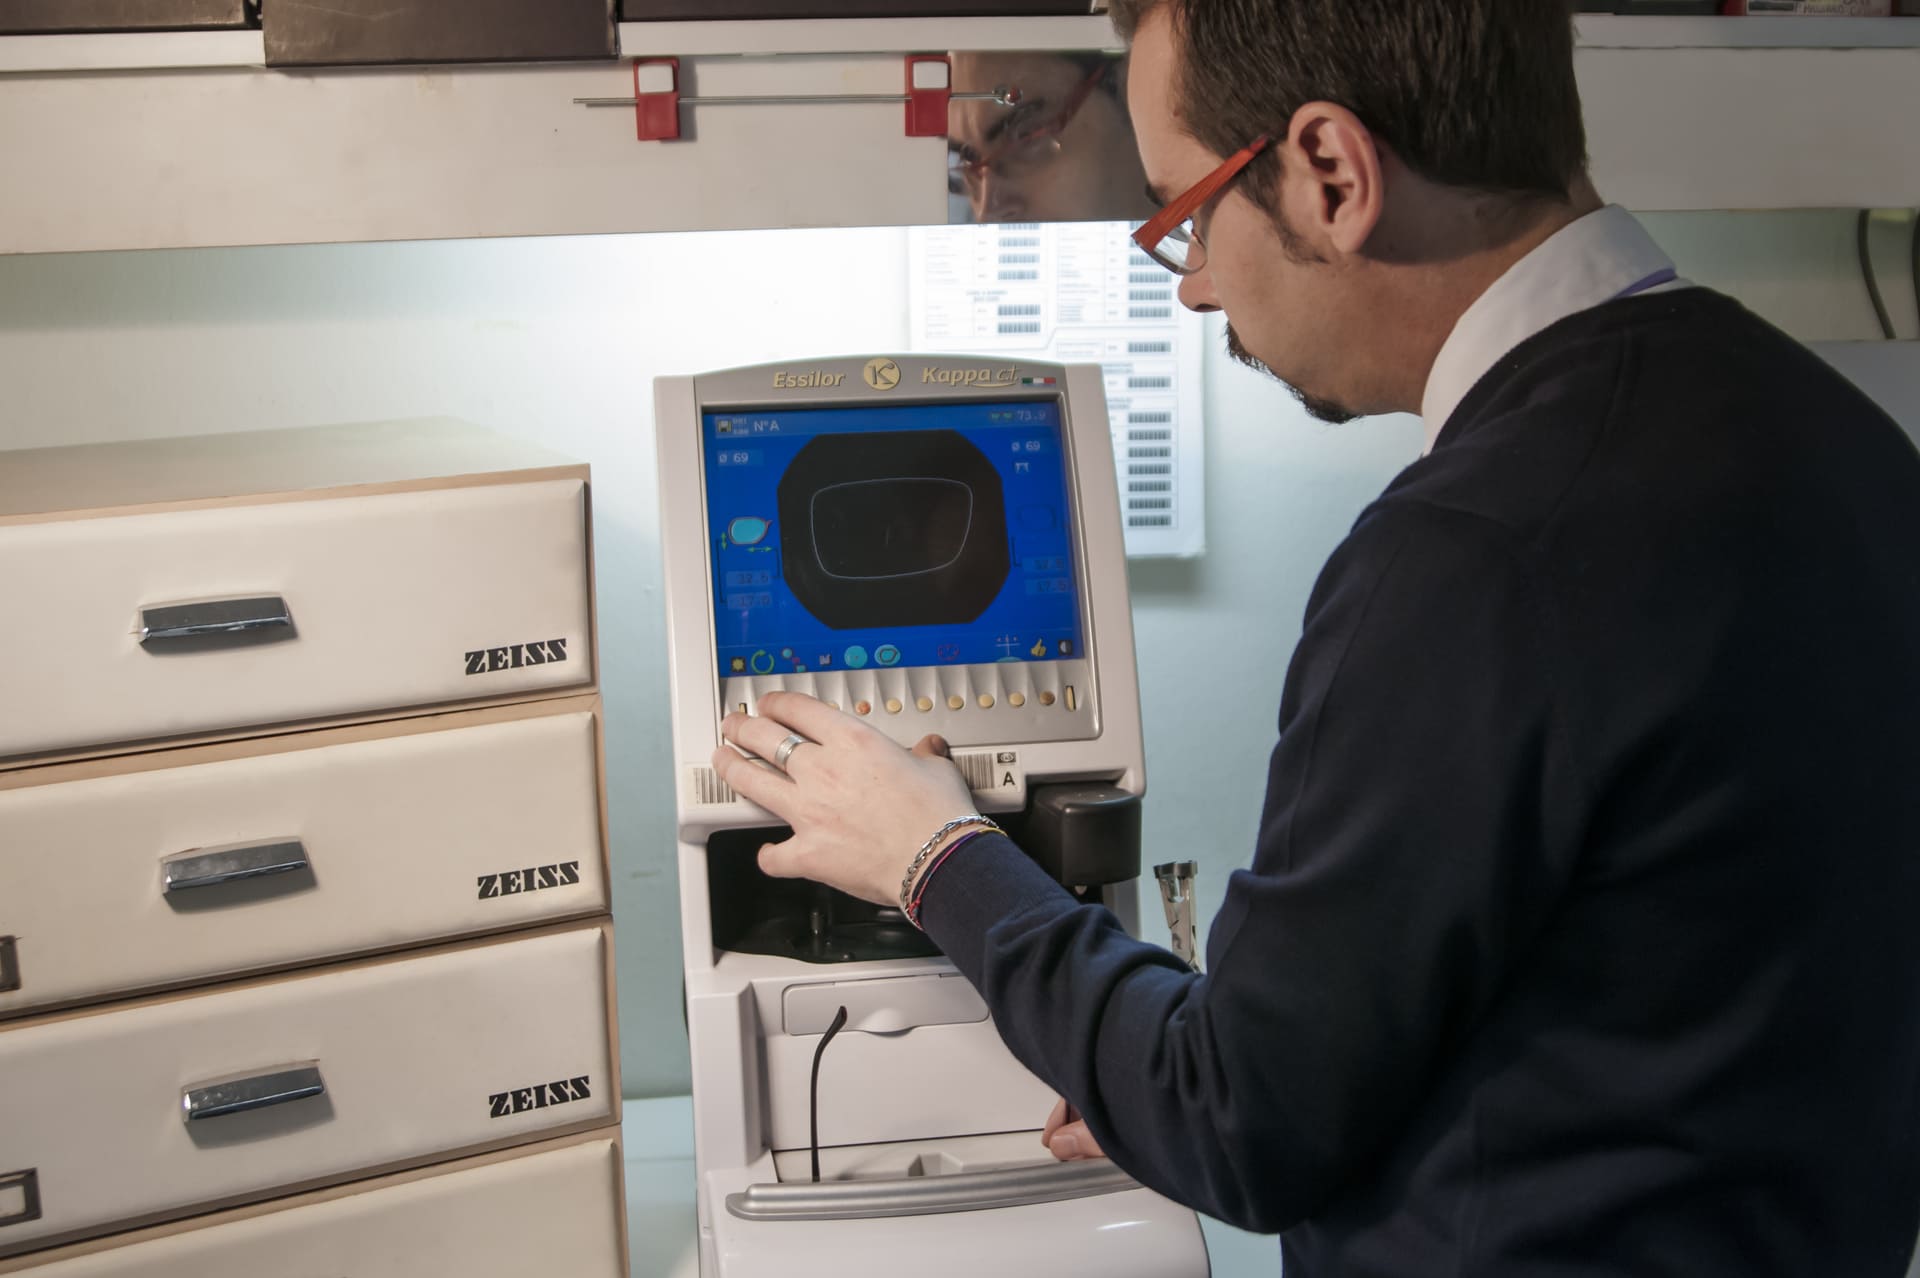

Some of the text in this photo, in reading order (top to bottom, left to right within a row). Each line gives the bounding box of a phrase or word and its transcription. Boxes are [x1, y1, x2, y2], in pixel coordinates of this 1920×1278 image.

[774, 369, 846, 388] Essilor
[922, 367, 992, 386] Kappa
[1025, 440, 1041, 451] 69
[733, 452, 749, 463] 69
[465, 638, 567, 675] ZEISS
[1003, 771, 1016, 786] A
[478, 860, 580, 900] ZEISS
[489, 1075, 591, 1118] ZEISS
